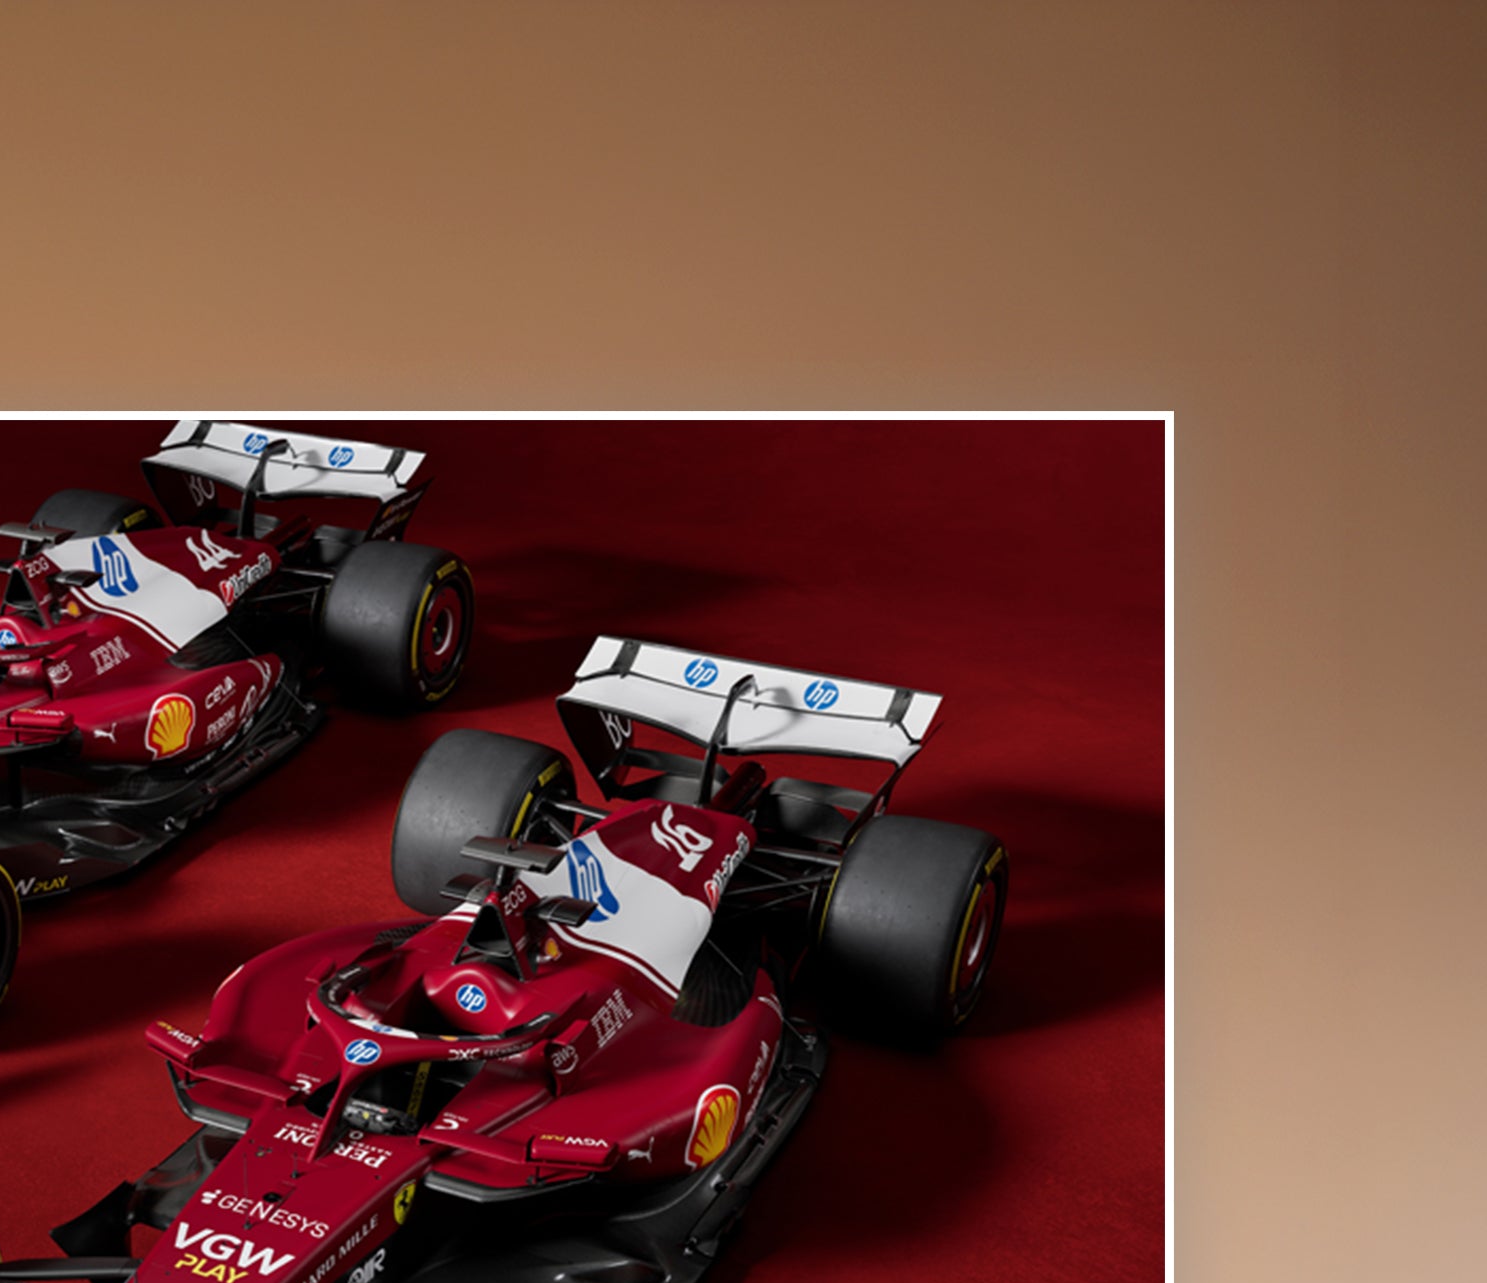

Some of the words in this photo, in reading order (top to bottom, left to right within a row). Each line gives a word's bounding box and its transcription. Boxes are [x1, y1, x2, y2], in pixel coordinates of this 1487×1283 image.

[243, 432, 269, 454] hp
[328, 446, 354, 468] hp
[92, 536, 139, 597] hp
[185, 528, 242, 572] 44
[90, 636, 131, 675] IBM
[684, 657, 719, 688] hp
[804, 679, 839, 709] hp
[651, 804, 713, 872] 16
[567, 839, 620, 922] hp
[456, 984, 487, 1013] hp
[344, 1039, 381, 1065] hp
[217, 1193, 330, 1238] GENESYS
[174, 1222, 295, 1276] VGW
[338, 1215, 379, 1260] MILLE
